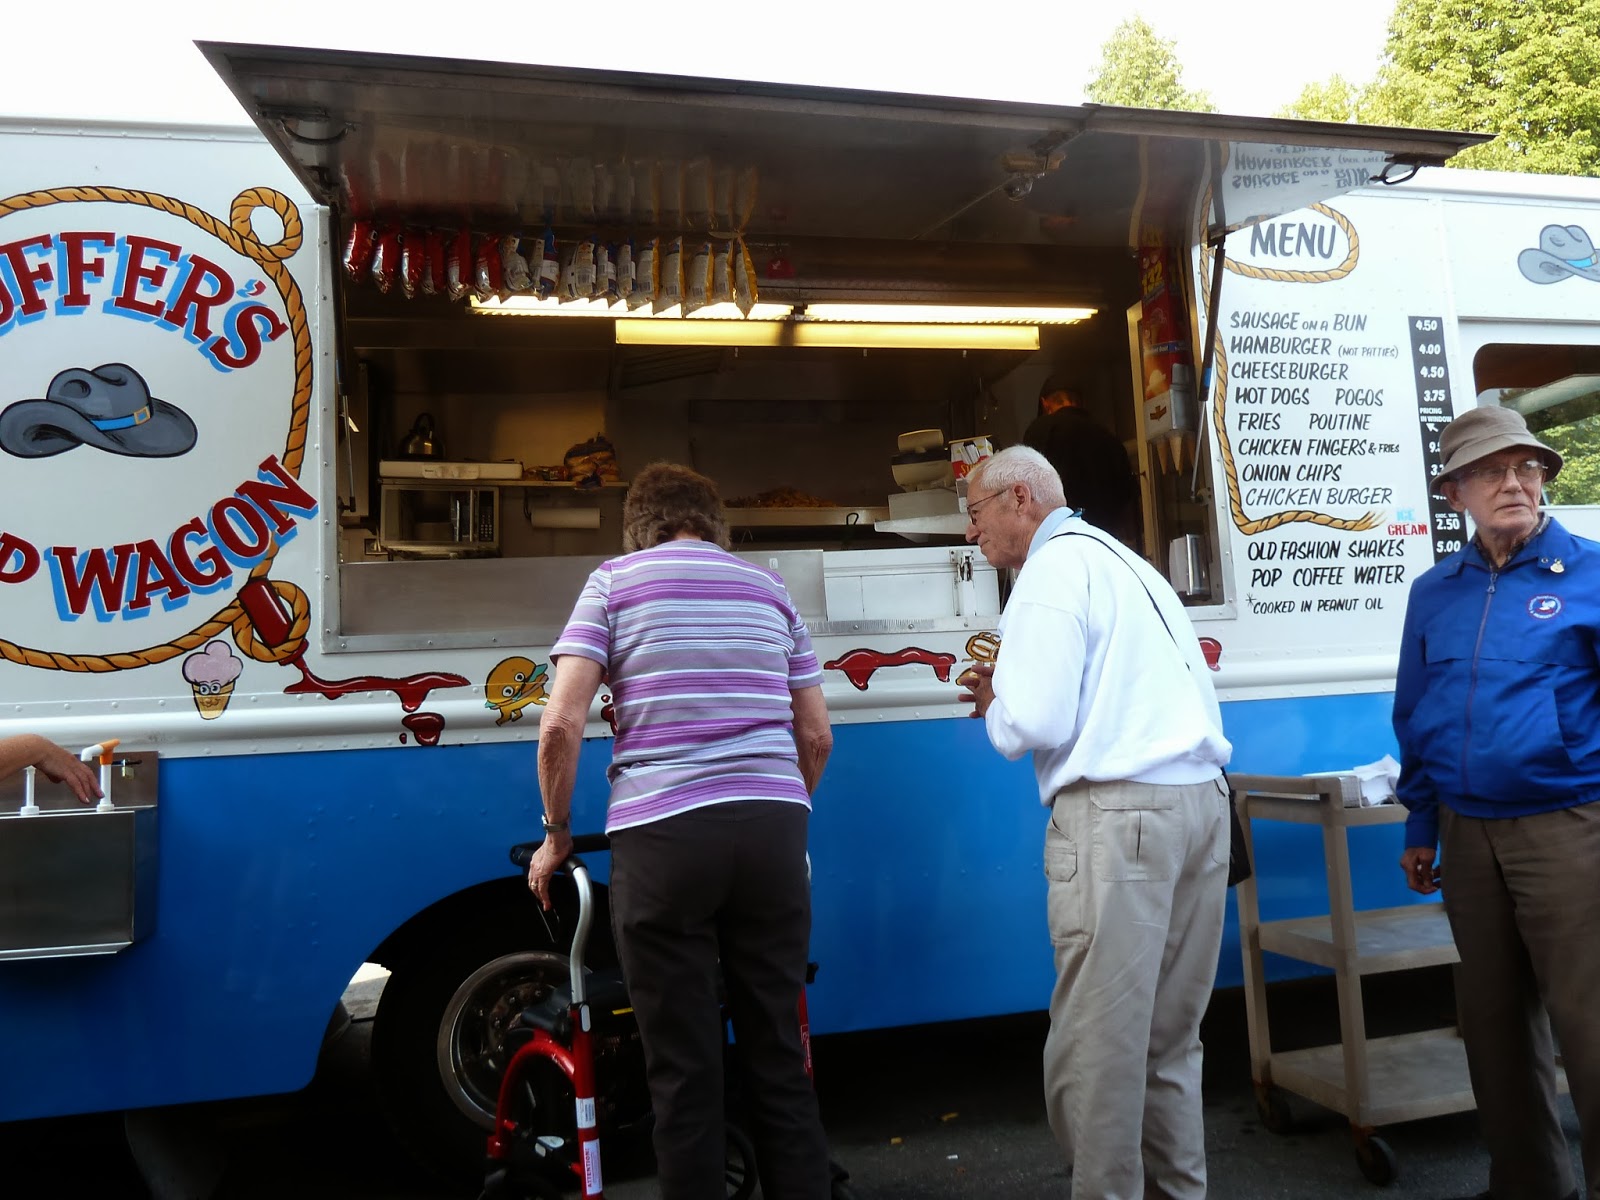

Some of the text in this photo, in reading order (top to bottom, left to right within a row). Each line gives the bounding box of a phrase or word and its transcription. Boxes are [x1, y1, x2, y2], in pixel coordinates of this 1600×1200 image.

[1250, 222, 1337, 259] MENU
[1230, 311, 1367, 331] SAUSAGE ON A BUN
[1416, 319, 1438, 331] 4.50
[1230, 335, 1399, 359] HAMBURGER (NOT PATTIES)
[1419, 343, 1441, 355] 4.00
[1231, 361, 1349, 380] CHEESEBURGER
[1420, 366, 1445, 379] 4.50
[1235, 386, 1384, 406] HOT DOGS POGOS
[1424, 389, 1446, 402] 3.75
[1238, 412, 1372, 431] FRIES POUTINE
[1238, 438, 1400, 456] CHICKEN FINGERS & FRIES
[1242, 463, 1342, 482] ONION CHIPS
[1246, 487, 1393, 506] CHICKEN BURGER
[1396, 508, 1415, 521] ICE
[1436, 518, 1460, 530] 2.50
[46, 454, 318, 619] WAGON
[1388, 523, 1428, 536] CREAM
[1248, 538, 1405, 561] OLD FASHION SHAKES
[1436, 540, 1461, 553] 5.00
[1251, 564, 1405, 587] POP COFFEE WATER
[1300, 600, 1312, 612] IN
[1317, 598, 1359, 612] PEANUT
[1365, 597, 1384, 610] OIL
